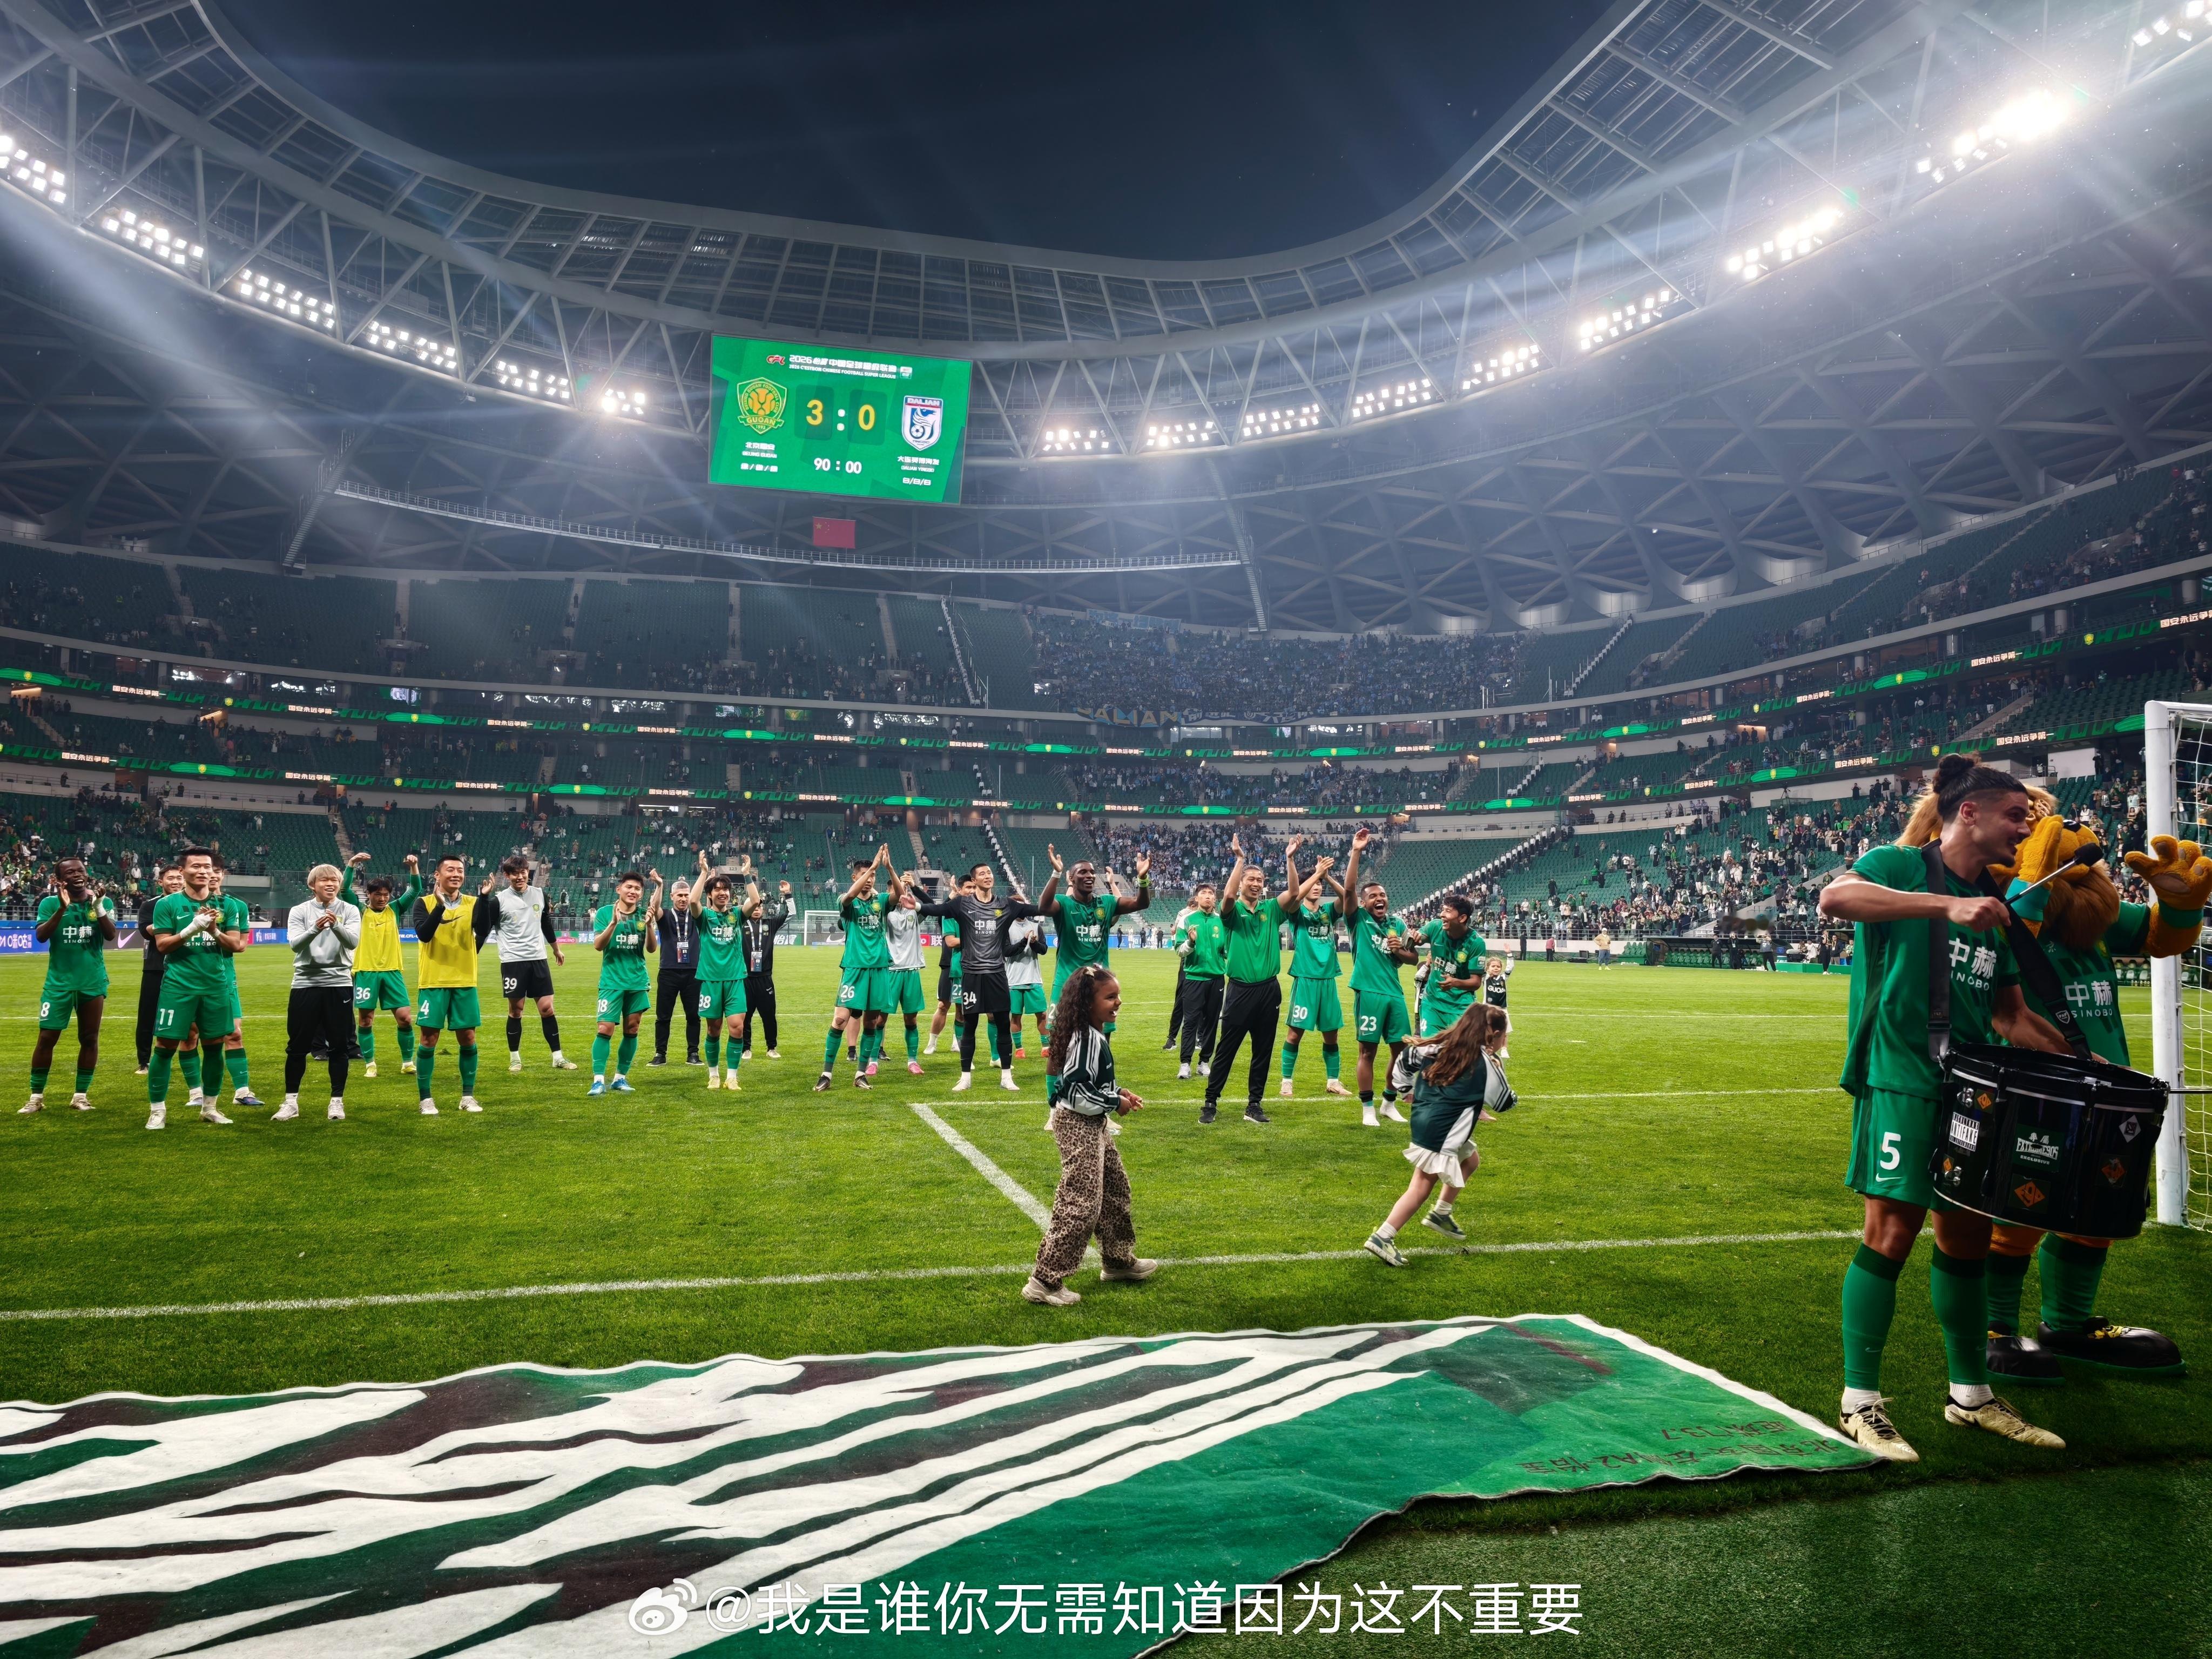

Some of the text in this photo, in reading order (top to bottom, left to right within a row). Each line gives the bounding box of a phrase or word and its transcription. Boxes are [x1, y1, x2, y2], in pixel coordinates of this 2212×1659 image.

[746, 417, 775, 426] GUOAN
[806, 400, 824, 426] 3
[858, 404, 875, 430] 0
[814, 458, 831, 471] 90
[845, 461, 862, 474] 00
[858, 915, 879, 926] 中赫
[975, 920, 996, 930] 中赫
[63, 926, 92, 939] 中赫
[712, 927, 733, 937] 中赫
[1076, 924, 1101, 937] 中赫
[1308, 926, 1328, 936] 中赫
[616, 934, 638, 945] 中赫
[1948, 938, 1997, 980] 中赫
[503, 977, 517, 990] 39
[1951, 970, 1990, 991] INOBO
[355, 987, 370, 1000] 36
[840, 985, 855, 999] 26
[963, 992, 976, 1006] 34
[2065, 980, 2113, 1008] 中赫
[41, 1002, 50, 1017] 8
[420, 1000, 429, 1015] 4
[598, 999, 608, 1013] 18
[1292, 1005, 1307, 1020] 30
[160, 1008, 174, 1026] 11
[2071, 1009, 2113, 1018] SINOBO
[1360, 1016, 1377, 1031] 23
[1951, 1121, 1978, 1144] ANTIFAKE
[1879, 1131, 1901, 1170] 5
[2020, 1155, 2050, 1165] EXCLUSIVE
